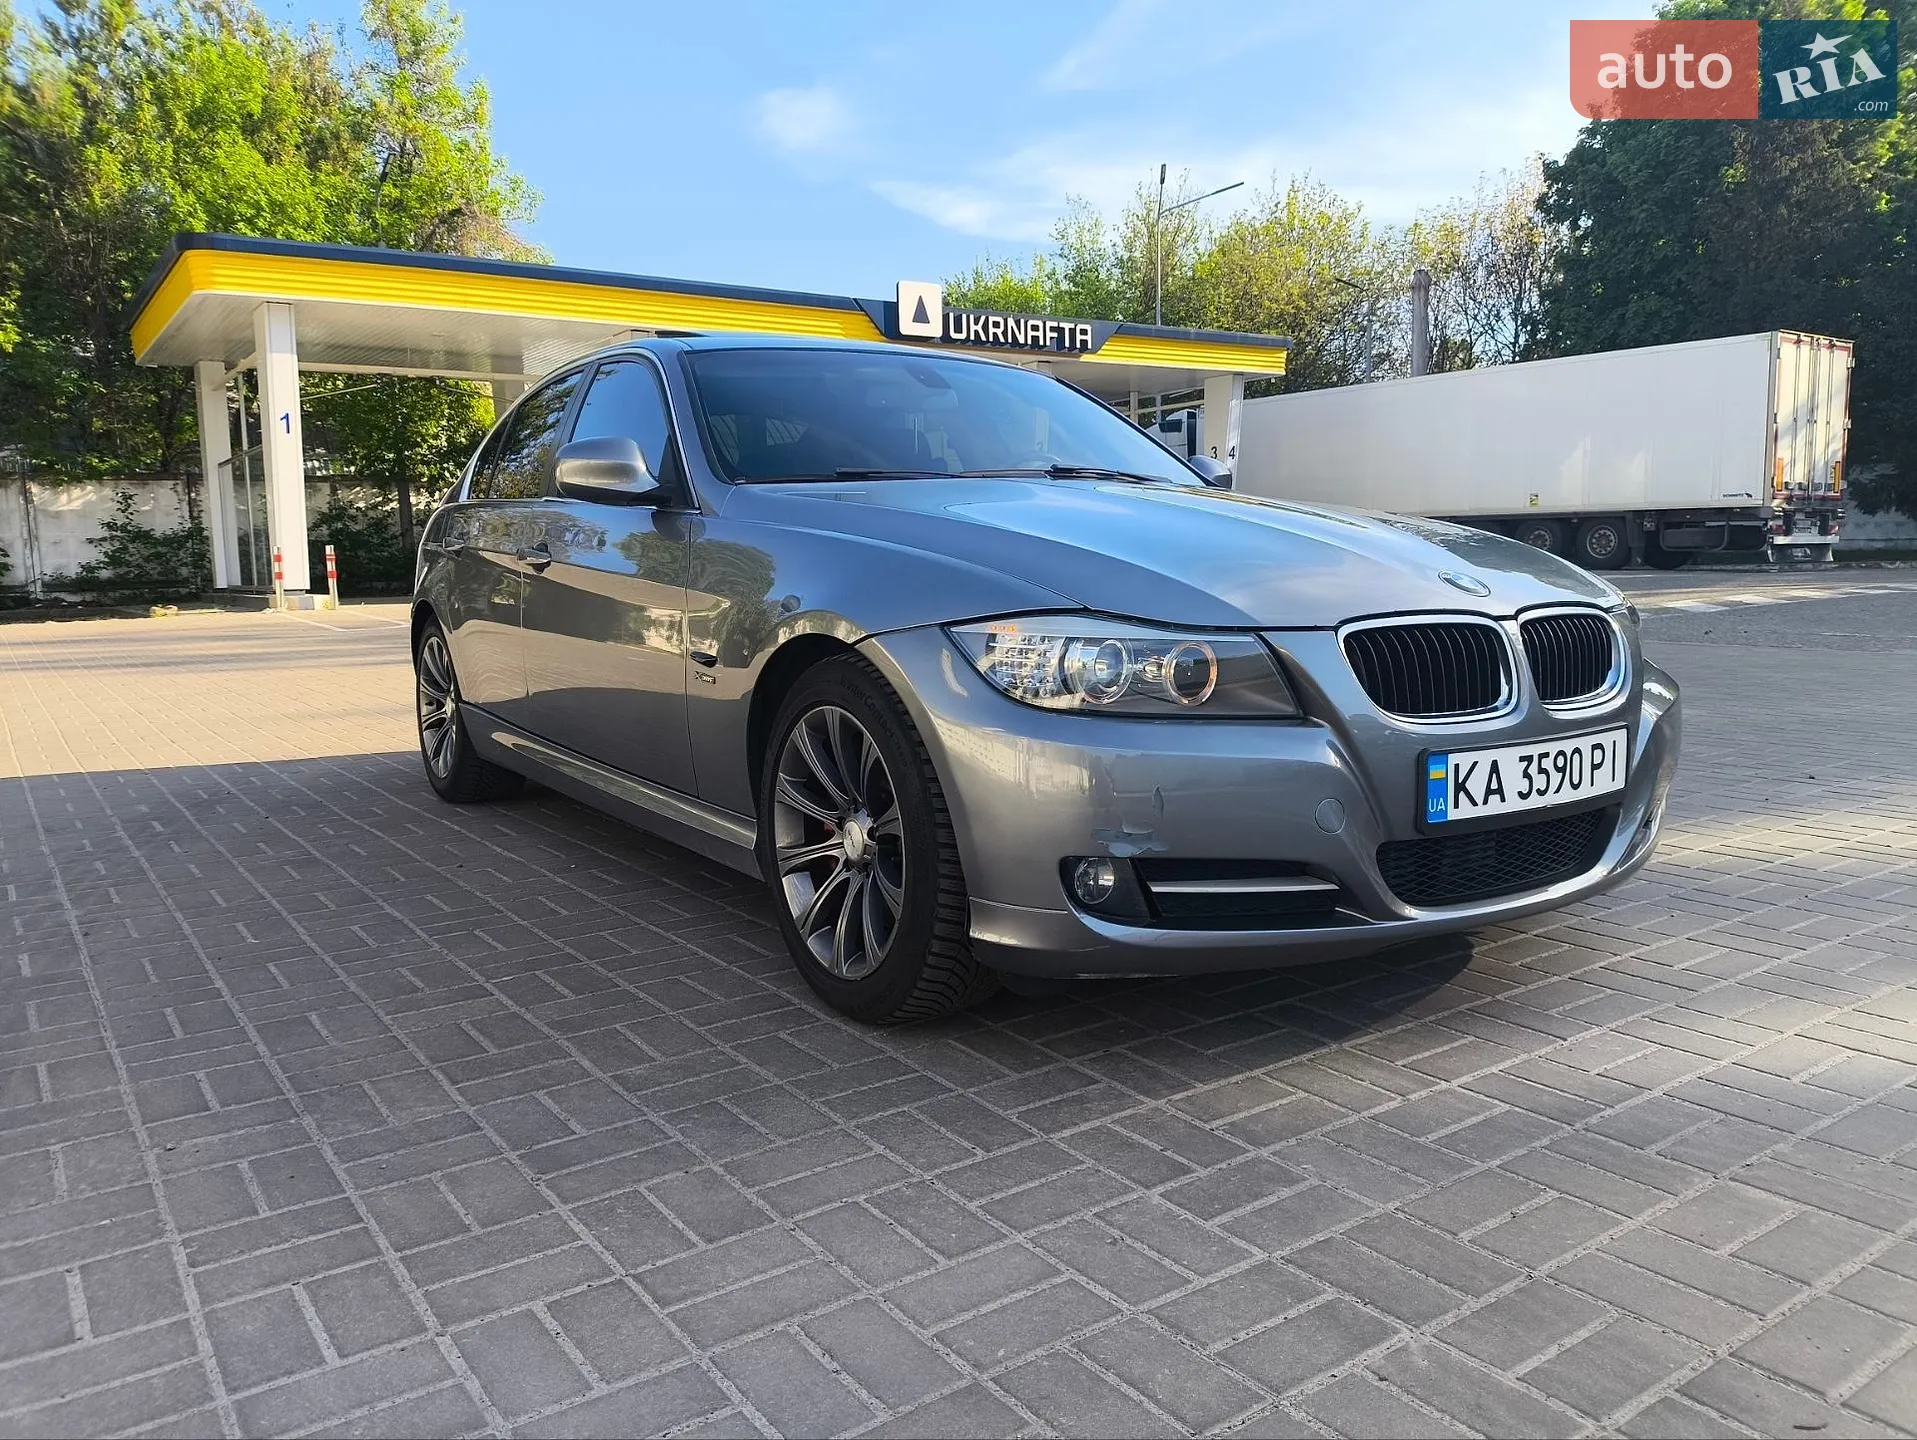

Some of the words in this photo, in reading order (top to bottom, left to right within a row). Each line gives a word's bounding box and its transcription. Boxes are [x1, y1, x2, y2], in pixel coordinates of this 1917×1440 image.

[949, 312, 1092, 350] UKRNAFTA
[280, 412, 290, 434] 1
[1210, 445, 1218, 460] 3
[1228, 445, 1236, 460] 4
[1453, 759, 1507, 810] KA
[1517, 746, 1583, 801] 3590
[1590, 739, 1617, 788] PI
[1428, 797, 1446, 813] UA
